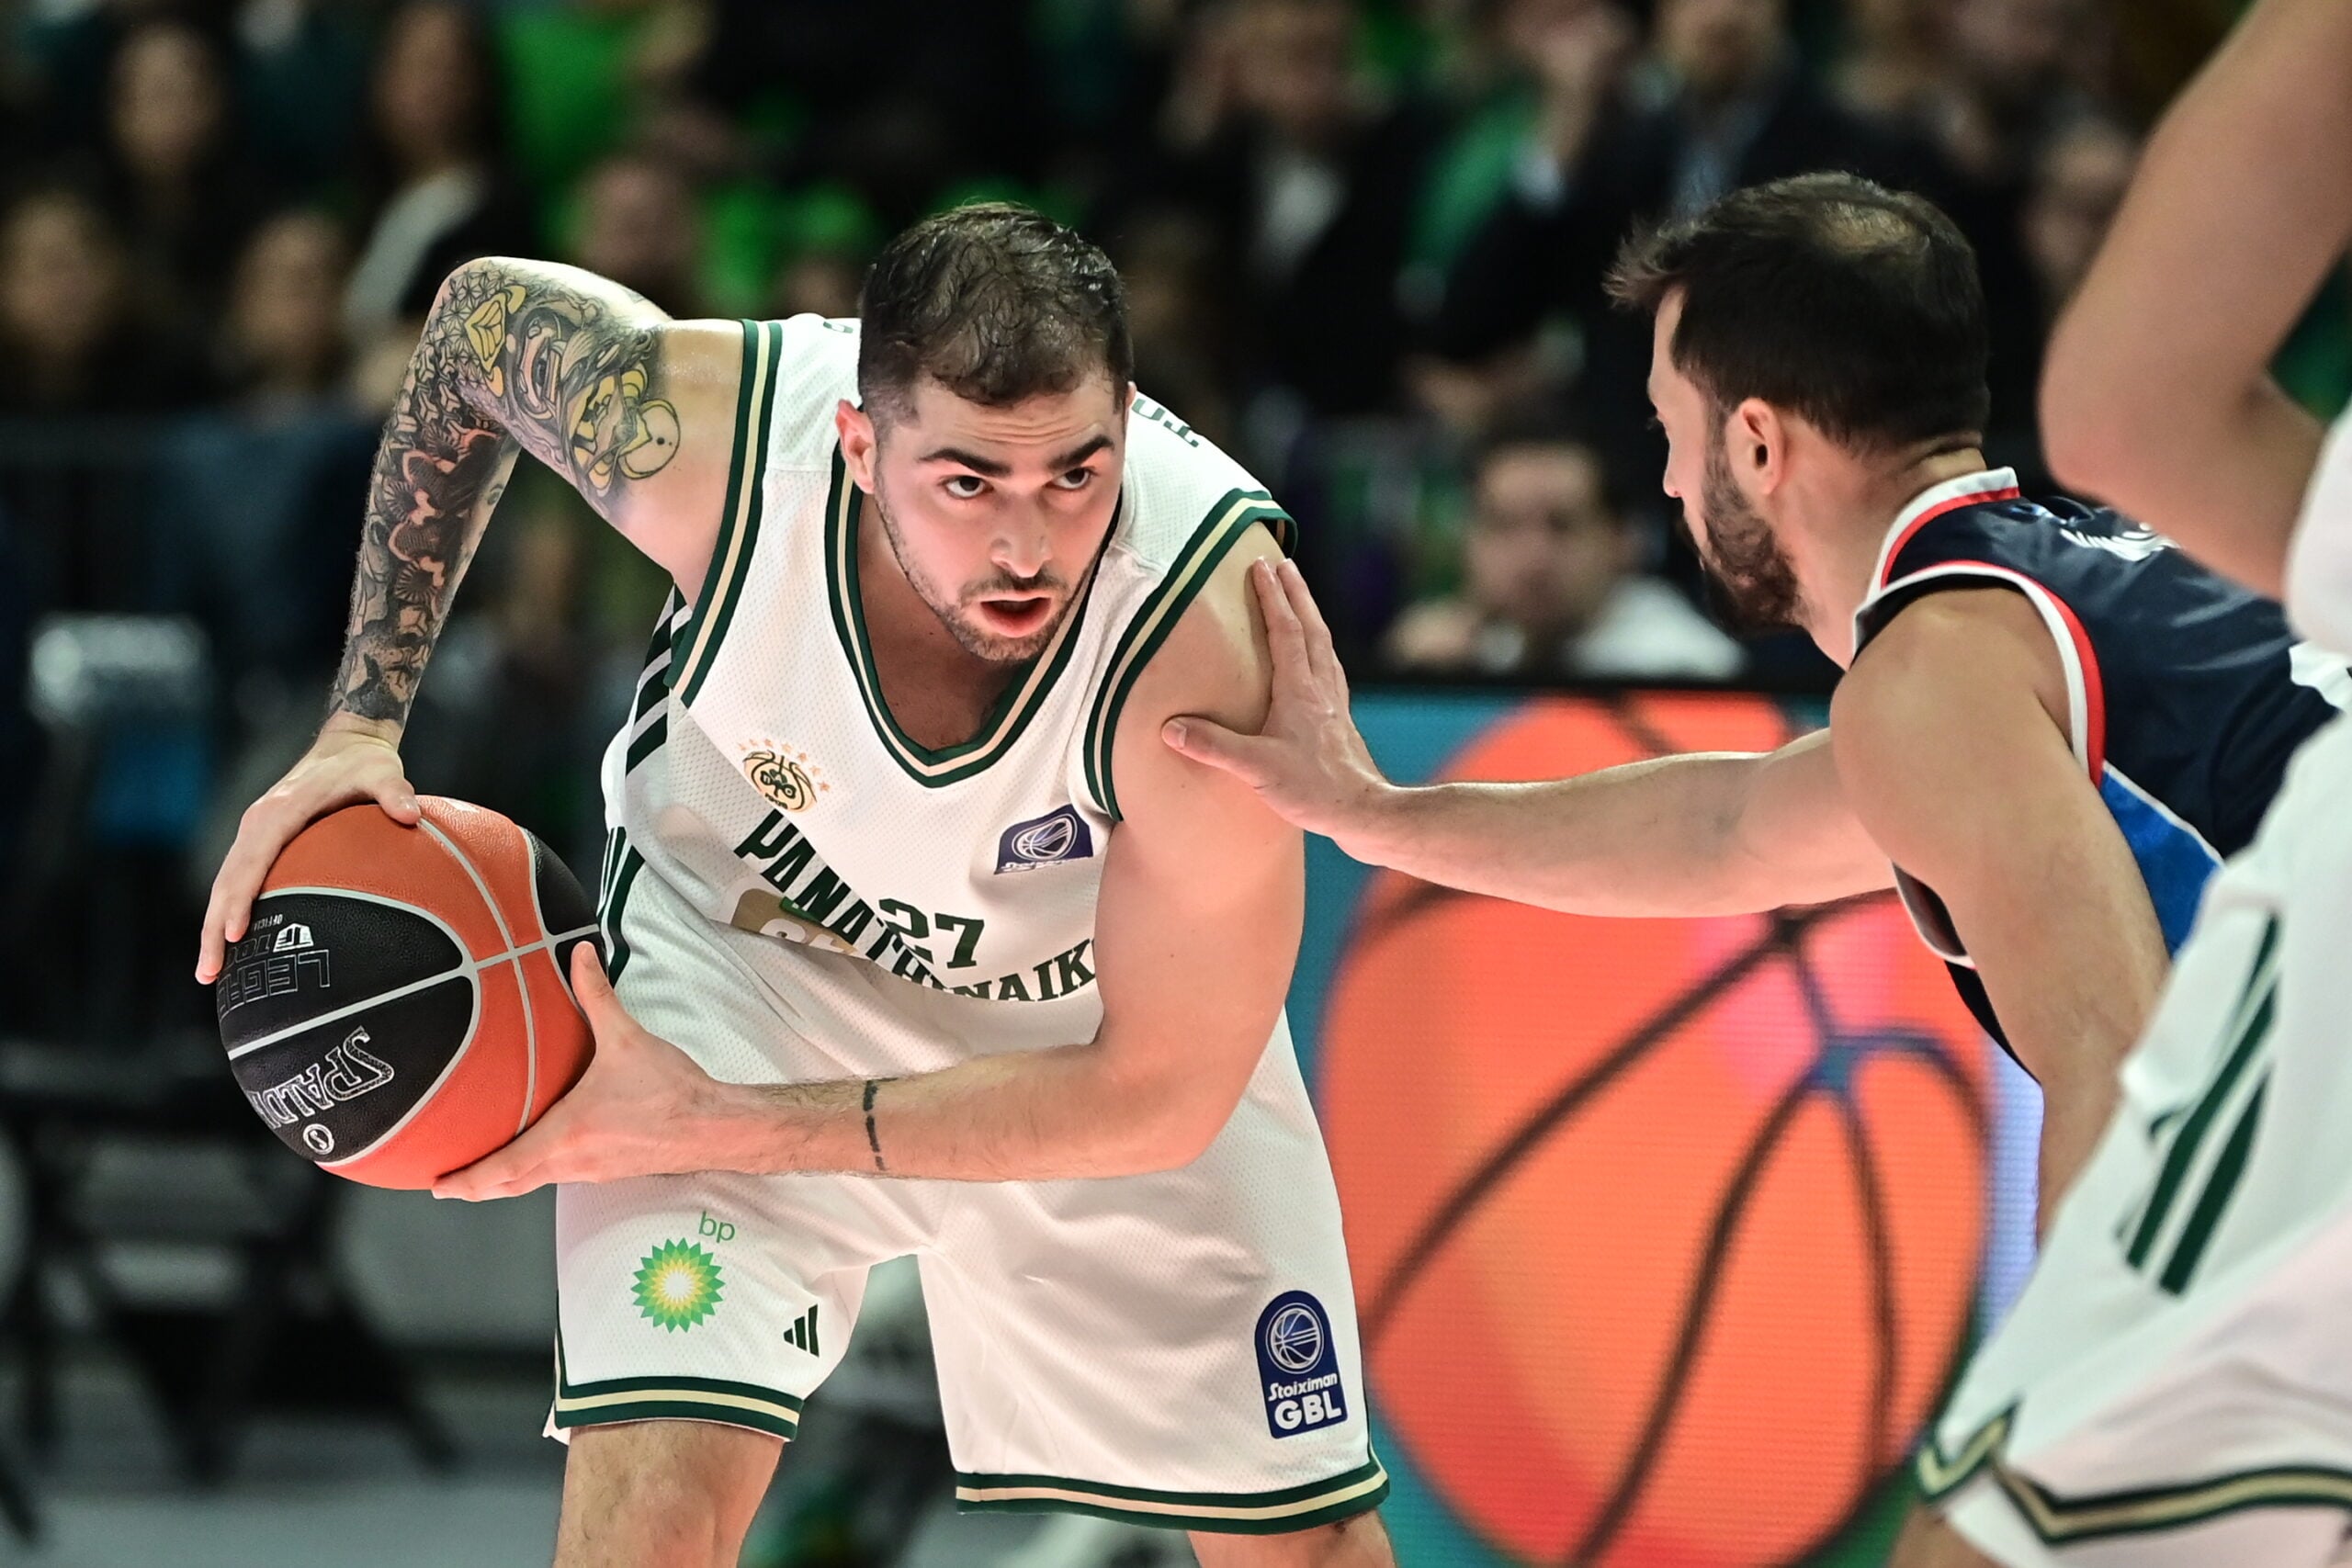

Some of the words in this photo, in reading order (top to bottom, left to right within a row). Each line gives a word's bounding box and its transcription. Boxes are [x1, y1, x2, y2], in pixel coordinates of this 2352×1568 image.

[878, 897, 985, 969] 27
[698, 1210, 736, 1244] bp
[1268, 1372, 1339, 1402] Stoiximan
[1274, 1391, 1342, 1430] GBL
